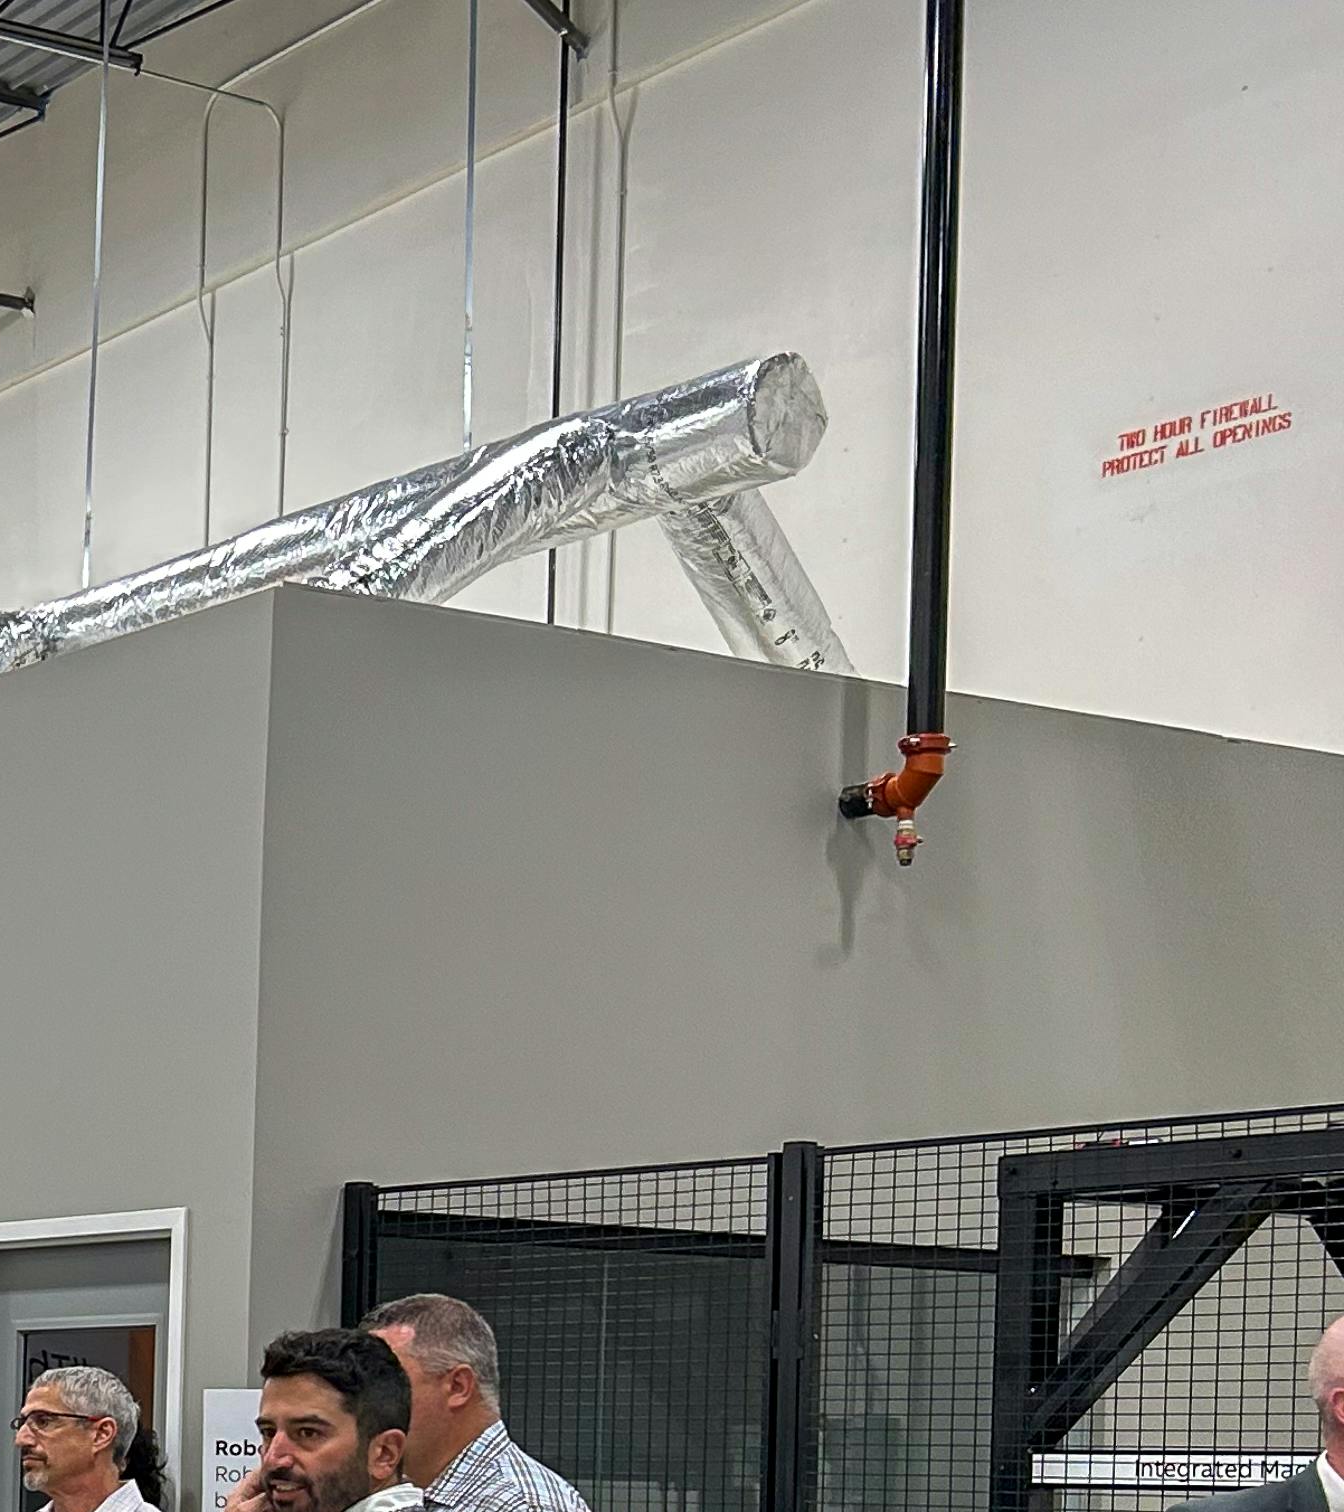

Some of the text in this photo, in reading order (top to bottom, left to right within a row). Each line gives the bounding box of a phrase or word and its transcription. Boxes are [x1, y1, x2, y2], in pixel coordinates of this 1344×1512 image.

[1101, 412, 1292, 478] PROTECT ALL OPENINGS
[1118, 393, 1278, 451] TWO HOUR FIREWALL
[1136, 1459, 1313, 1482] Integrated Mac
